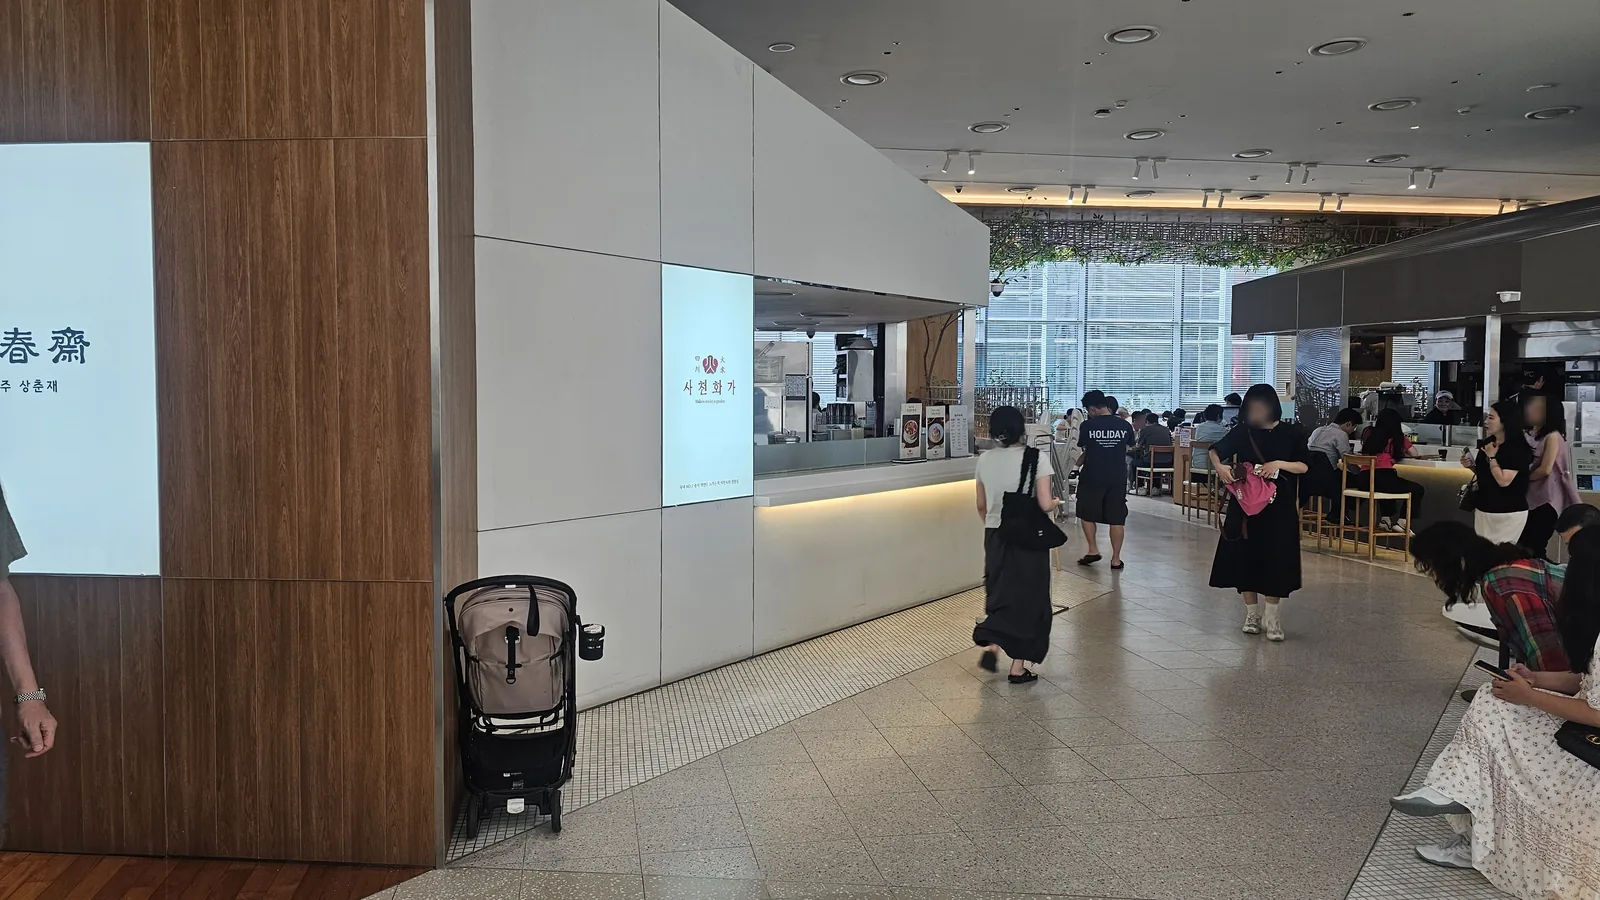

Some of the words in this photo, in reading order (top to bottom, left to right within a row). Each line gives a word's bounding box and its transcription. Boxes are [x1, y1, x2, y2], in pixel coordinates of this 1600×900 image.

[0, 327, 90, 364] 春齋
[19, 379, 58, 393] 상춘재
[682, 379, 736, 396] 사천화가
[1089, 430, 1127, 439] HOLIDAY
